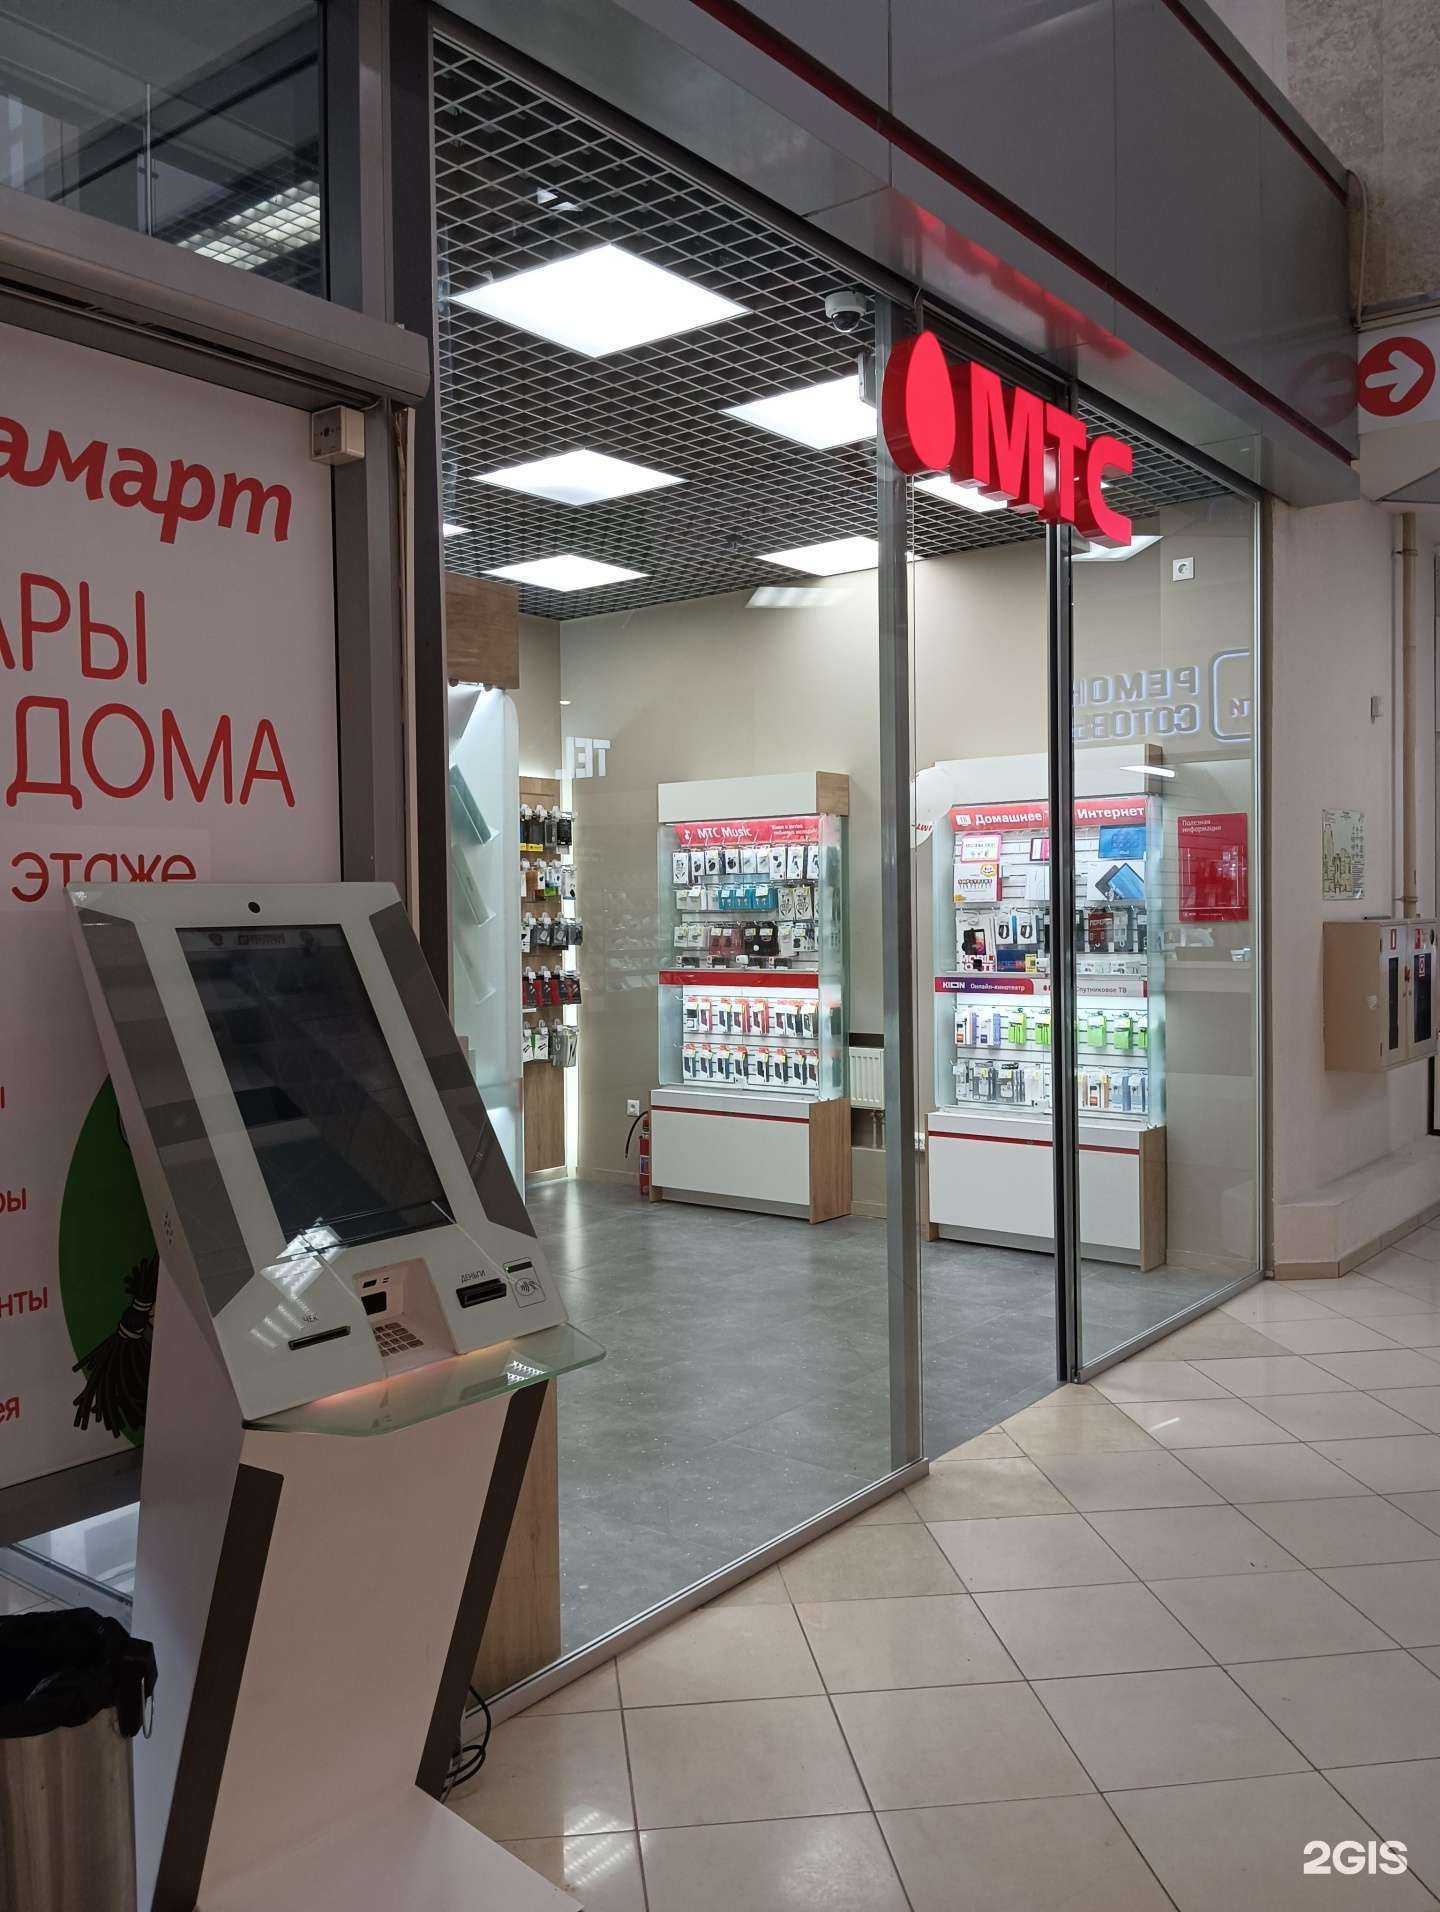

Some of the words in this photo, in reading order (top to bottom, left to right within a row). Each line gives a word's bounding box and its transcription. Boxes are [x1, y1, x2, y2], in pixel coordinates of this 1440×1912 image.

[968, 360, 1134, 547] МТС
[0, 572, 148, 685] РЫ
[5, 695, 296, 809] ДОМА
[975, 812, 1042, 826] Домашнее
[1077, 806, 1145, 822] Интернет
[1182, 818, 1211, 827] Полезная
[1182, 825, 1222, 834] информация
[697, 827, 721, 840] МТС
[722, 825, 753, 838] Music
